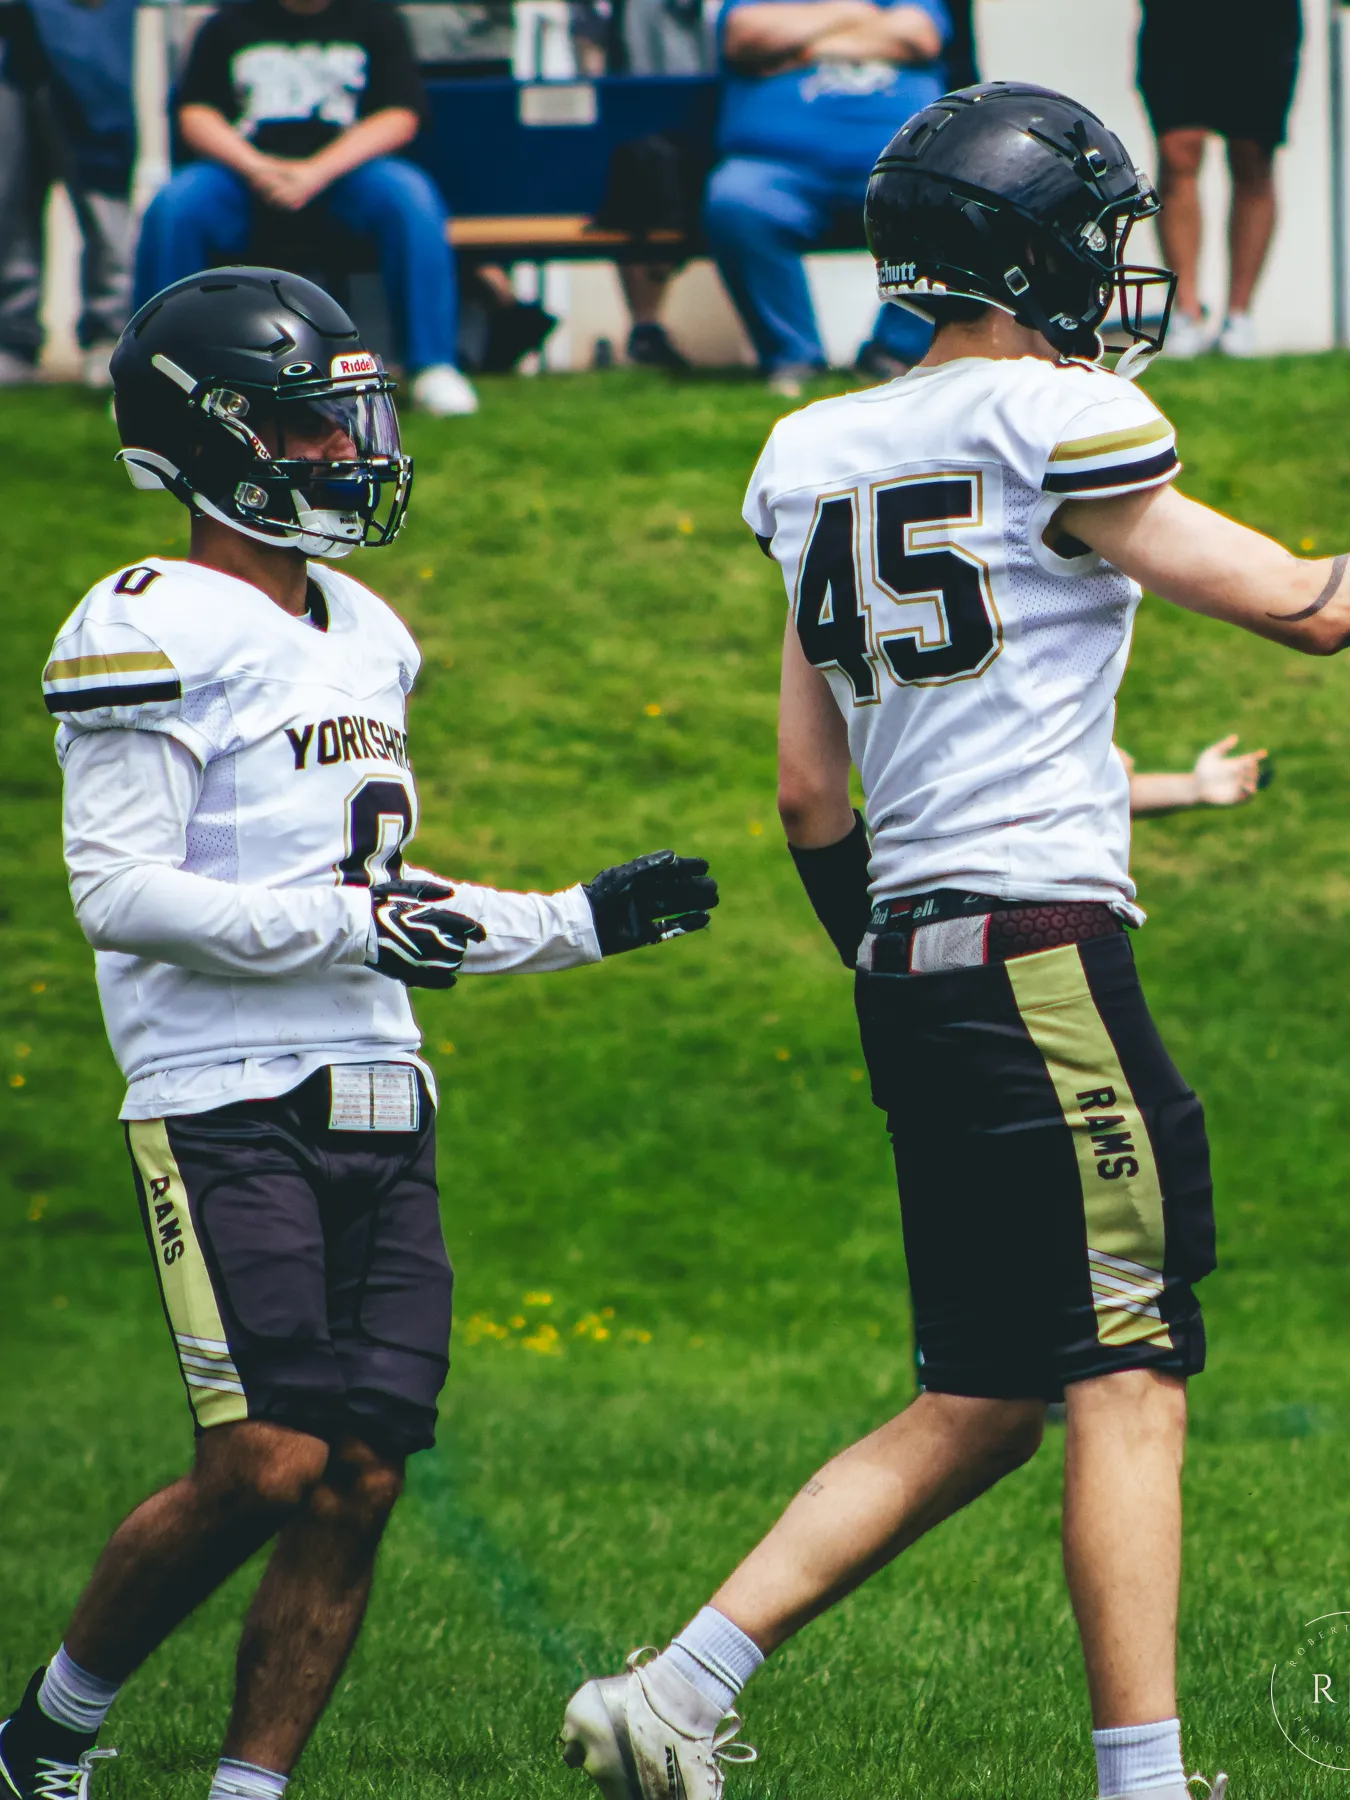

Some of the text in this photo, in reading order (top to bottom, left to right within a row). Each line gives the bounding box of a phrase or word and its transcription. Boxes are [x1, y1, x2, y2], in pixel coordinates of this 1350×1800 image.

[111, 566, 163, 597] 0
[792, 470, 1005, 708] 45
[1075, 1085, 1140, 1180] RAMS
[149, 1175, 185, 1266] RAMS
